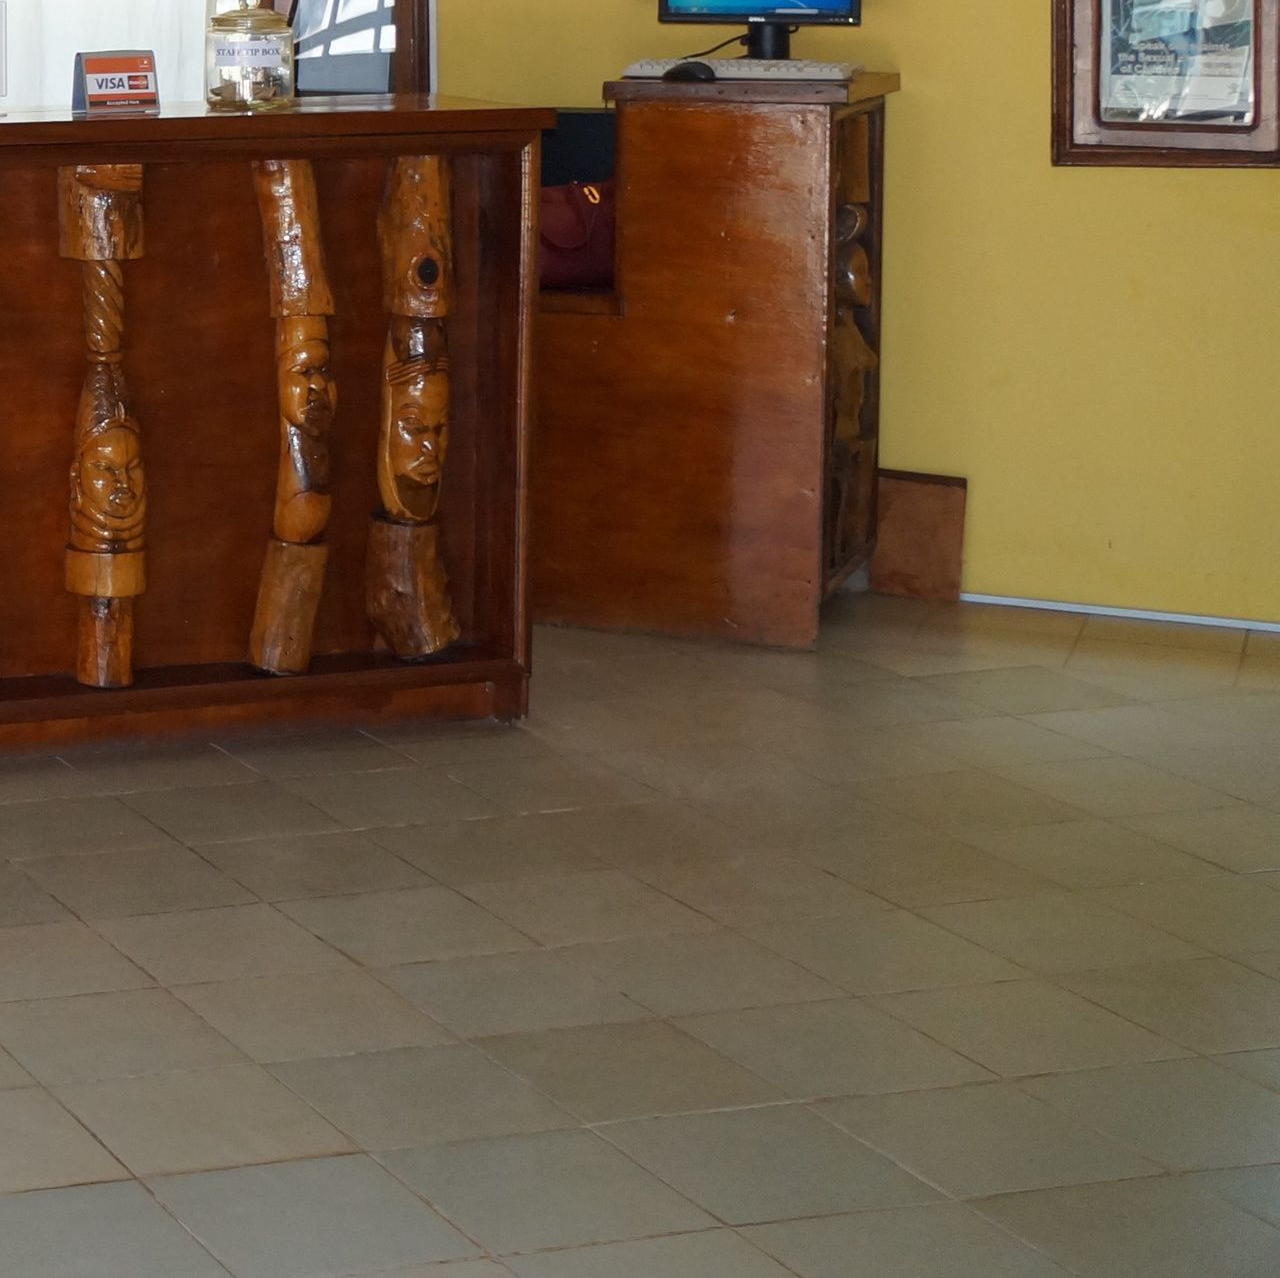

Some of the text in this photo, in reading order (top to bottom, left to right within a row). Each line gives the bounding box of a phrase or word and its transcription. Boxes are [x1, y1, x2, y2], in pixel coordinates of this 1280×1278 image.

[216, 48, 281, 57] STAFF TIP BOX
[95, 77, 126, 90] VISA
